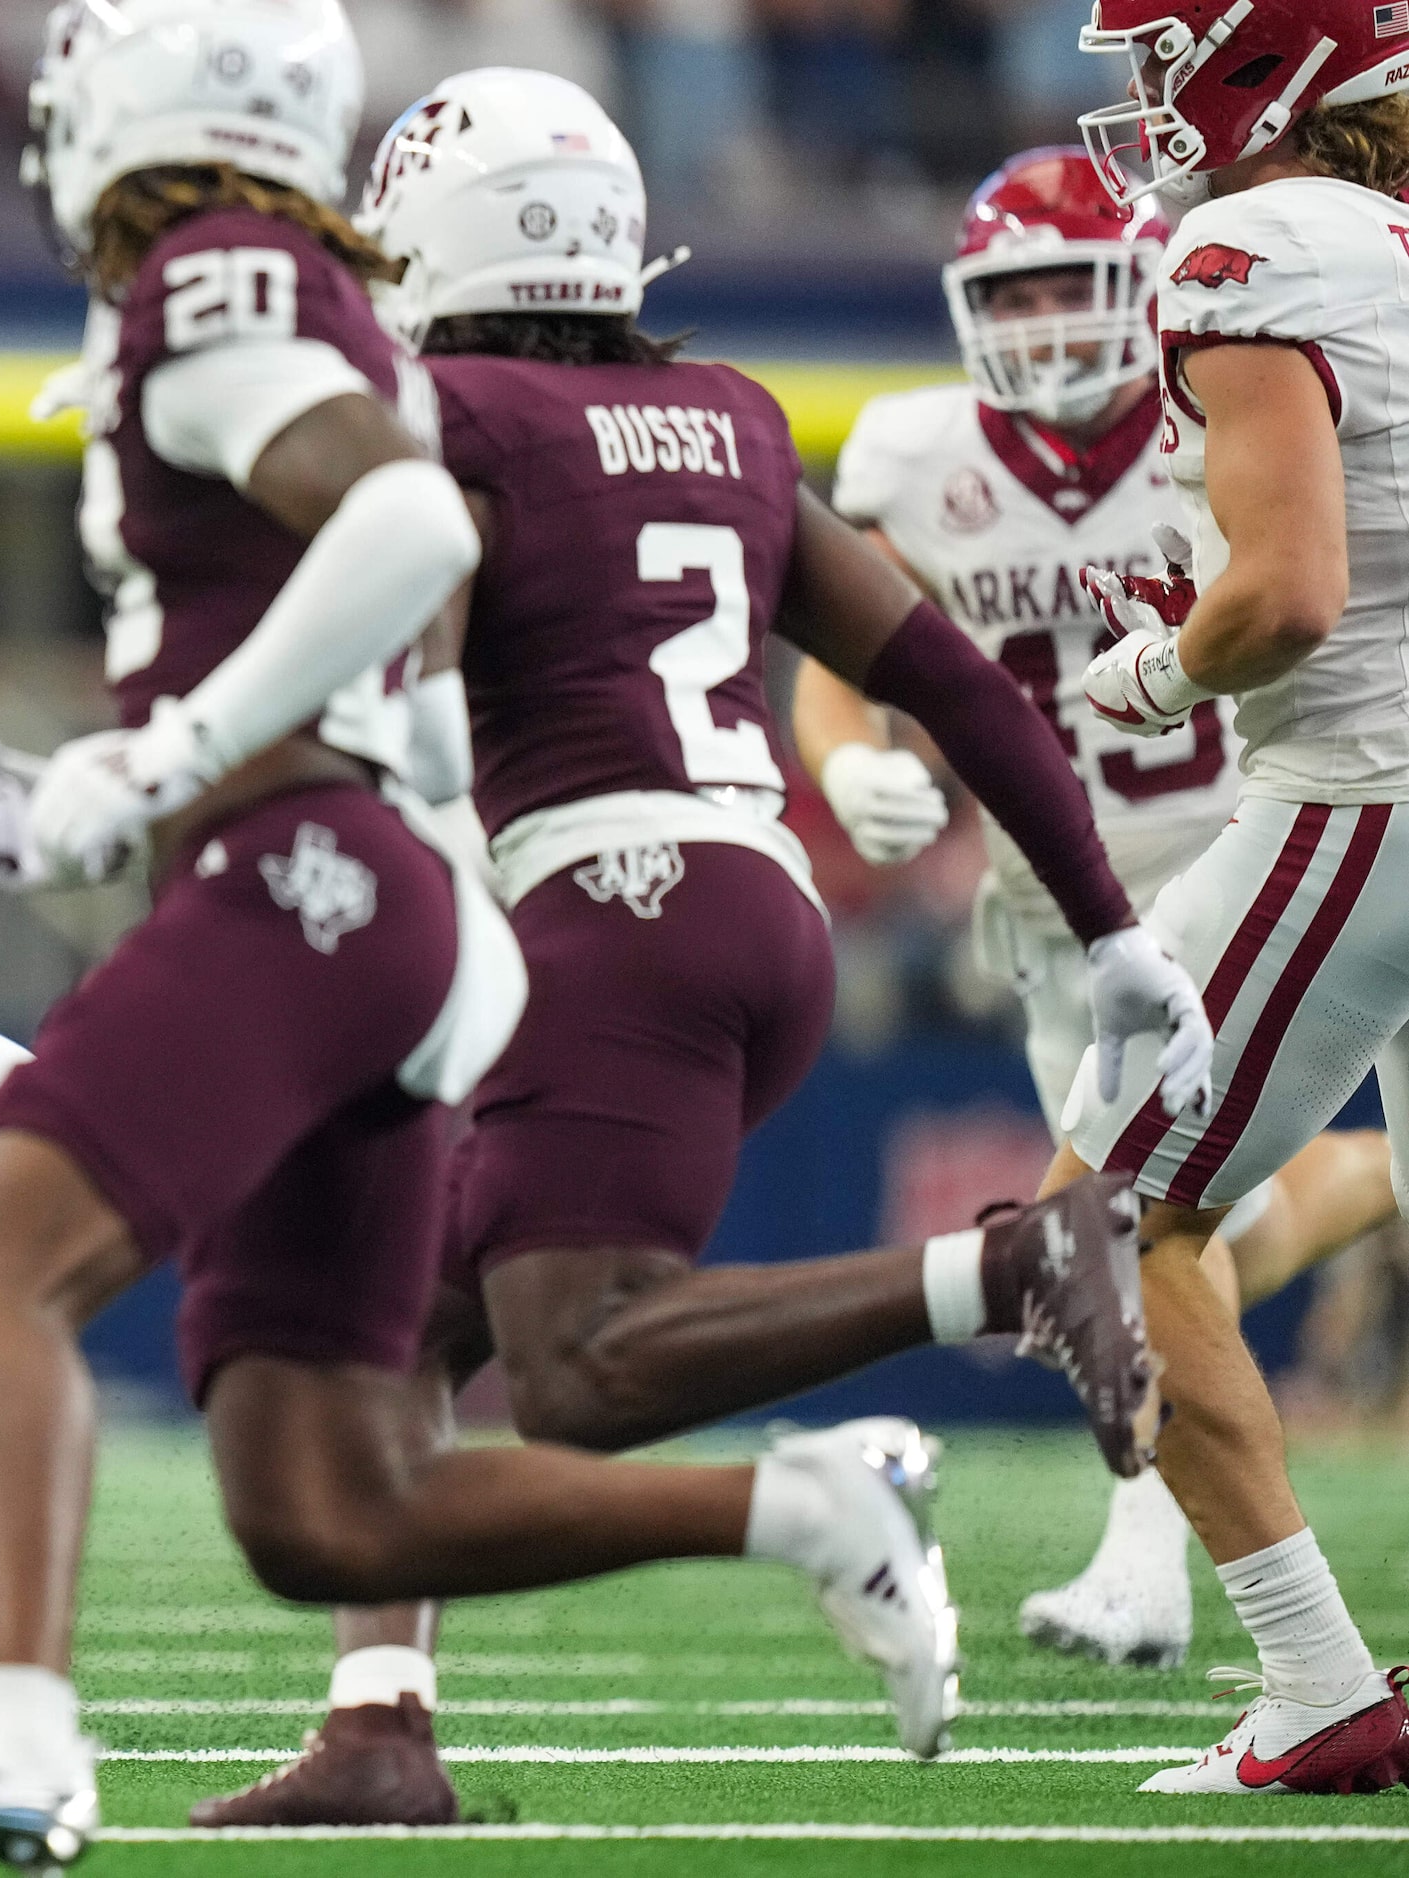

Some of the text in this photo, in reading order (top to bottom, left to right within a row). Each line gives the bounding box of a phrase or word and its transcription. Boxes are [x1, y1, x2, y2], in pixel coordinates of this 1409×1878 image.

[161, 246, 298, 352] 20
[584, 403, 743, 480] BUSSEY
[635, 521, 786, 792] 2
